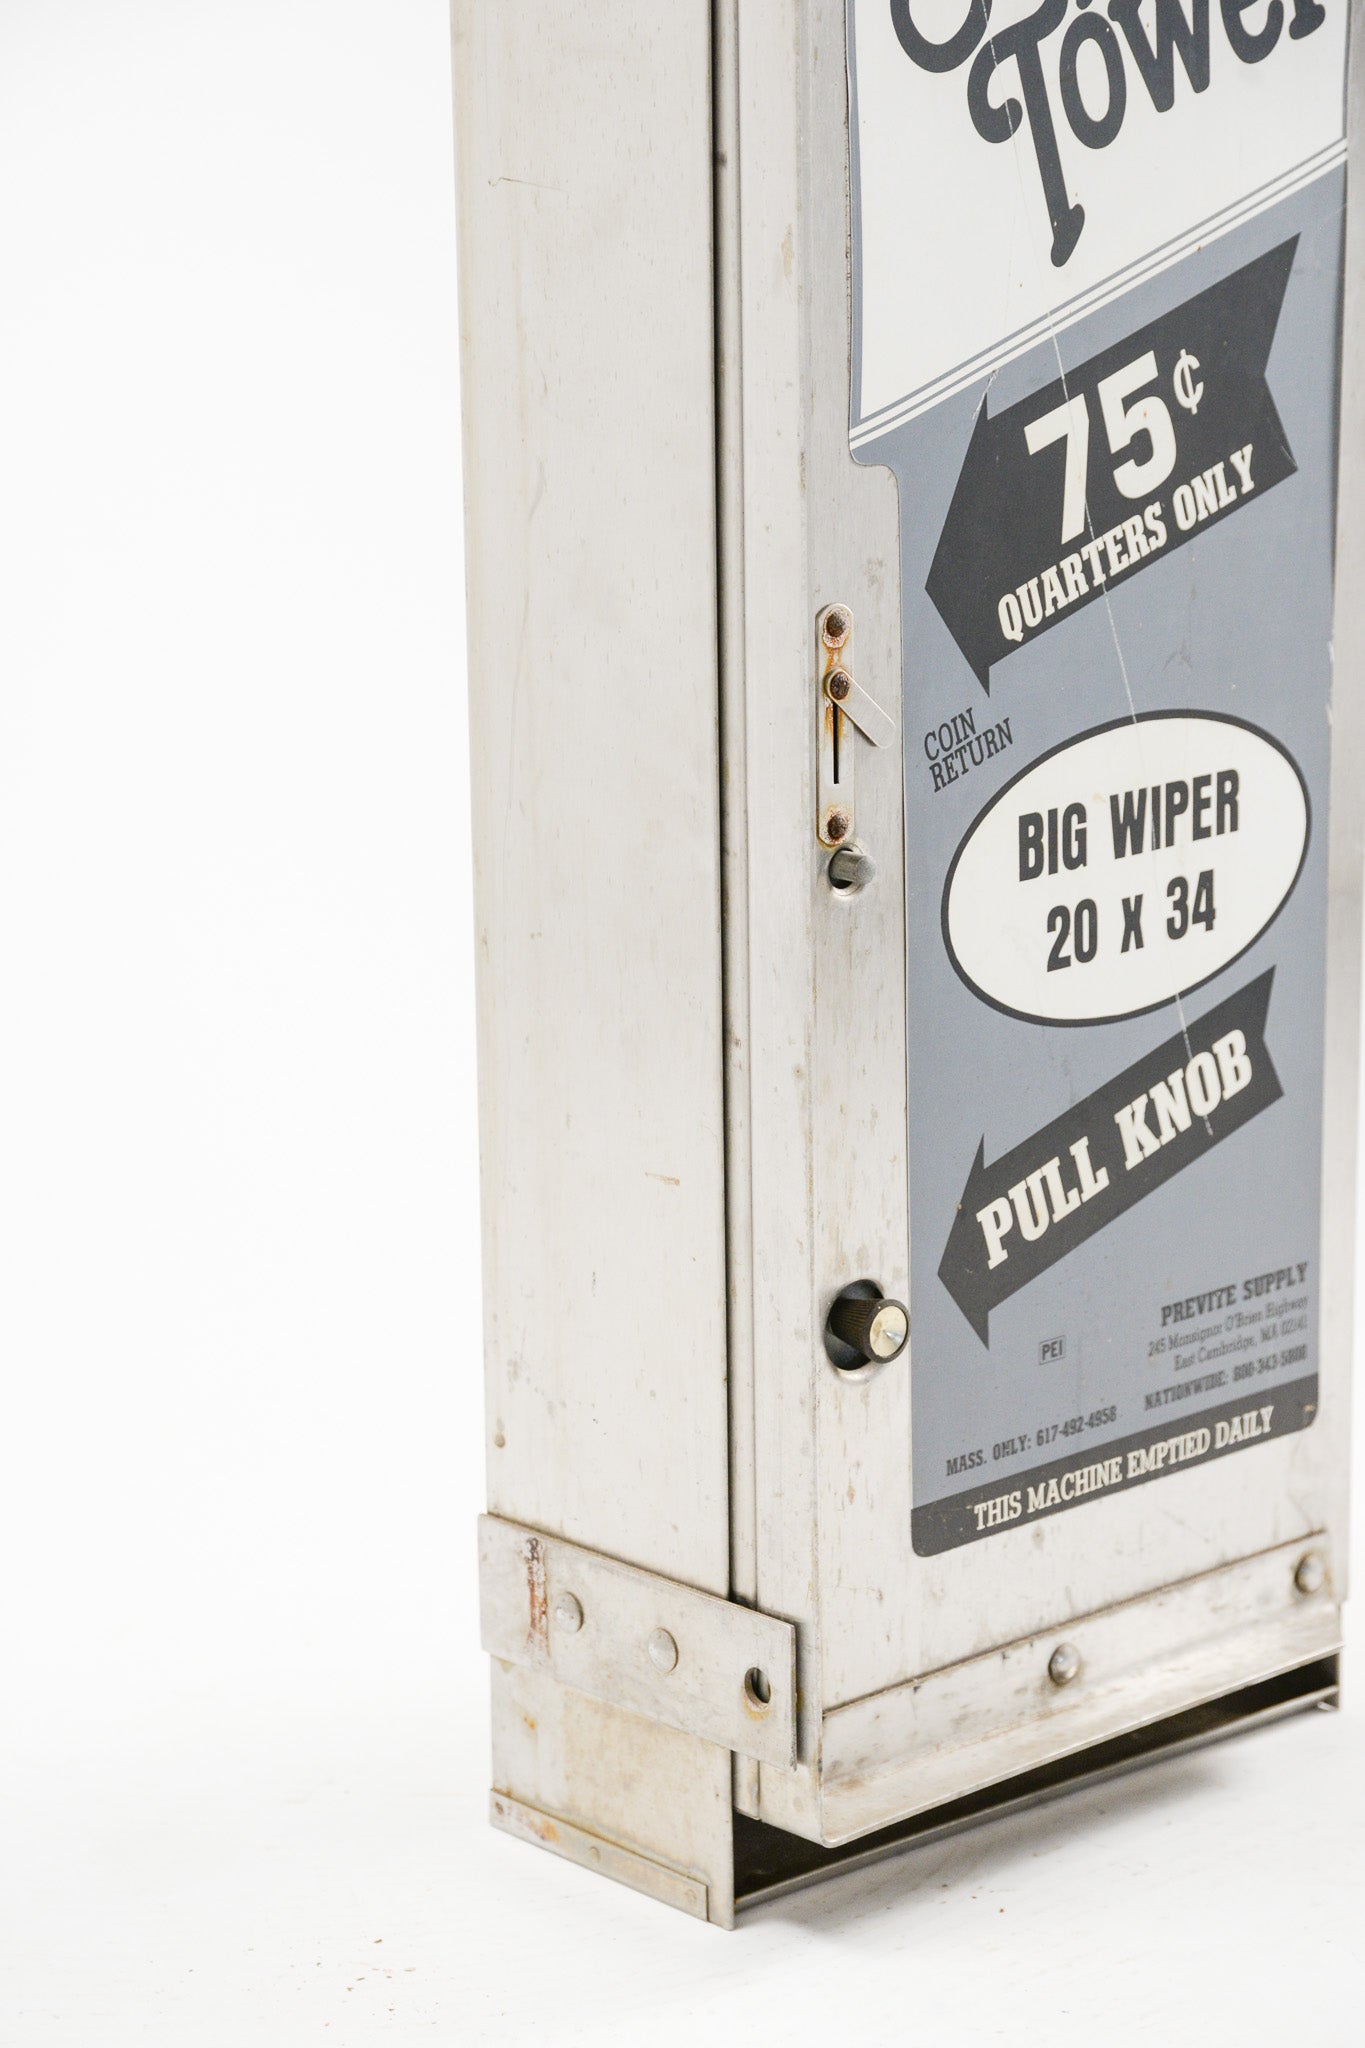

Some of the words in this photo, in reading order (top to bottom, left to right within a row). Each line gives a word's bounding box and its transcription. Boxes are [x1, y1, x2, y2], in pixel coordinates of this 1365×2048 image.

[998, 502, 1168, 642] QUARTERS
[1173, 444, 1255, 531] ONLY
[924, 707, 976, 761] COIN
[929, 718, 1013, 792] RETURN
[1018, 802, 1087, 882] BIG
[1109, 769, 1239, 860] WIPER
[1047, 899, 1098, 972] 20
[1166, 869, 1216, 941] 34
[976, 1136, 1109, 1270] PULL
[1114, 1029, 1253, 1169] KNOB
[1148, 1338, 1166, 1357] 245
[1168, 1324, 1222, 1350] Monsignor
[1224, 1310, 1262, 1332] O'Brien
[1265, 1296, 1309, 1320] Highway
[1161, 1284, 1237, 1327] PREVITE
[1243, 1262, 1308, 1300] SUPPLY
[1041, 1339, 1063, 1361] PEI
[1174, 1353, 1195, 1371] East
[1198, 1335, 1257, 1363] Cambridge,
[1260, 1323, 1278, 1342] MA
[1145, 1370, 1228, 1411] NATIONWIDE:
[946, 1449, 987, 1476] MASS.
[992, 1434, 1031, 1461] ONLY:
[1036, 1405, 1117, 1447] 617-492-4958
[974, 1490, 1022, 1531] THIS
[1026, 1456, 1122, 1513] MACHINE
[1126, 1427, 1211, 1478] EMPTIED
[1214, 1405, 1275, 1449] DAILY
